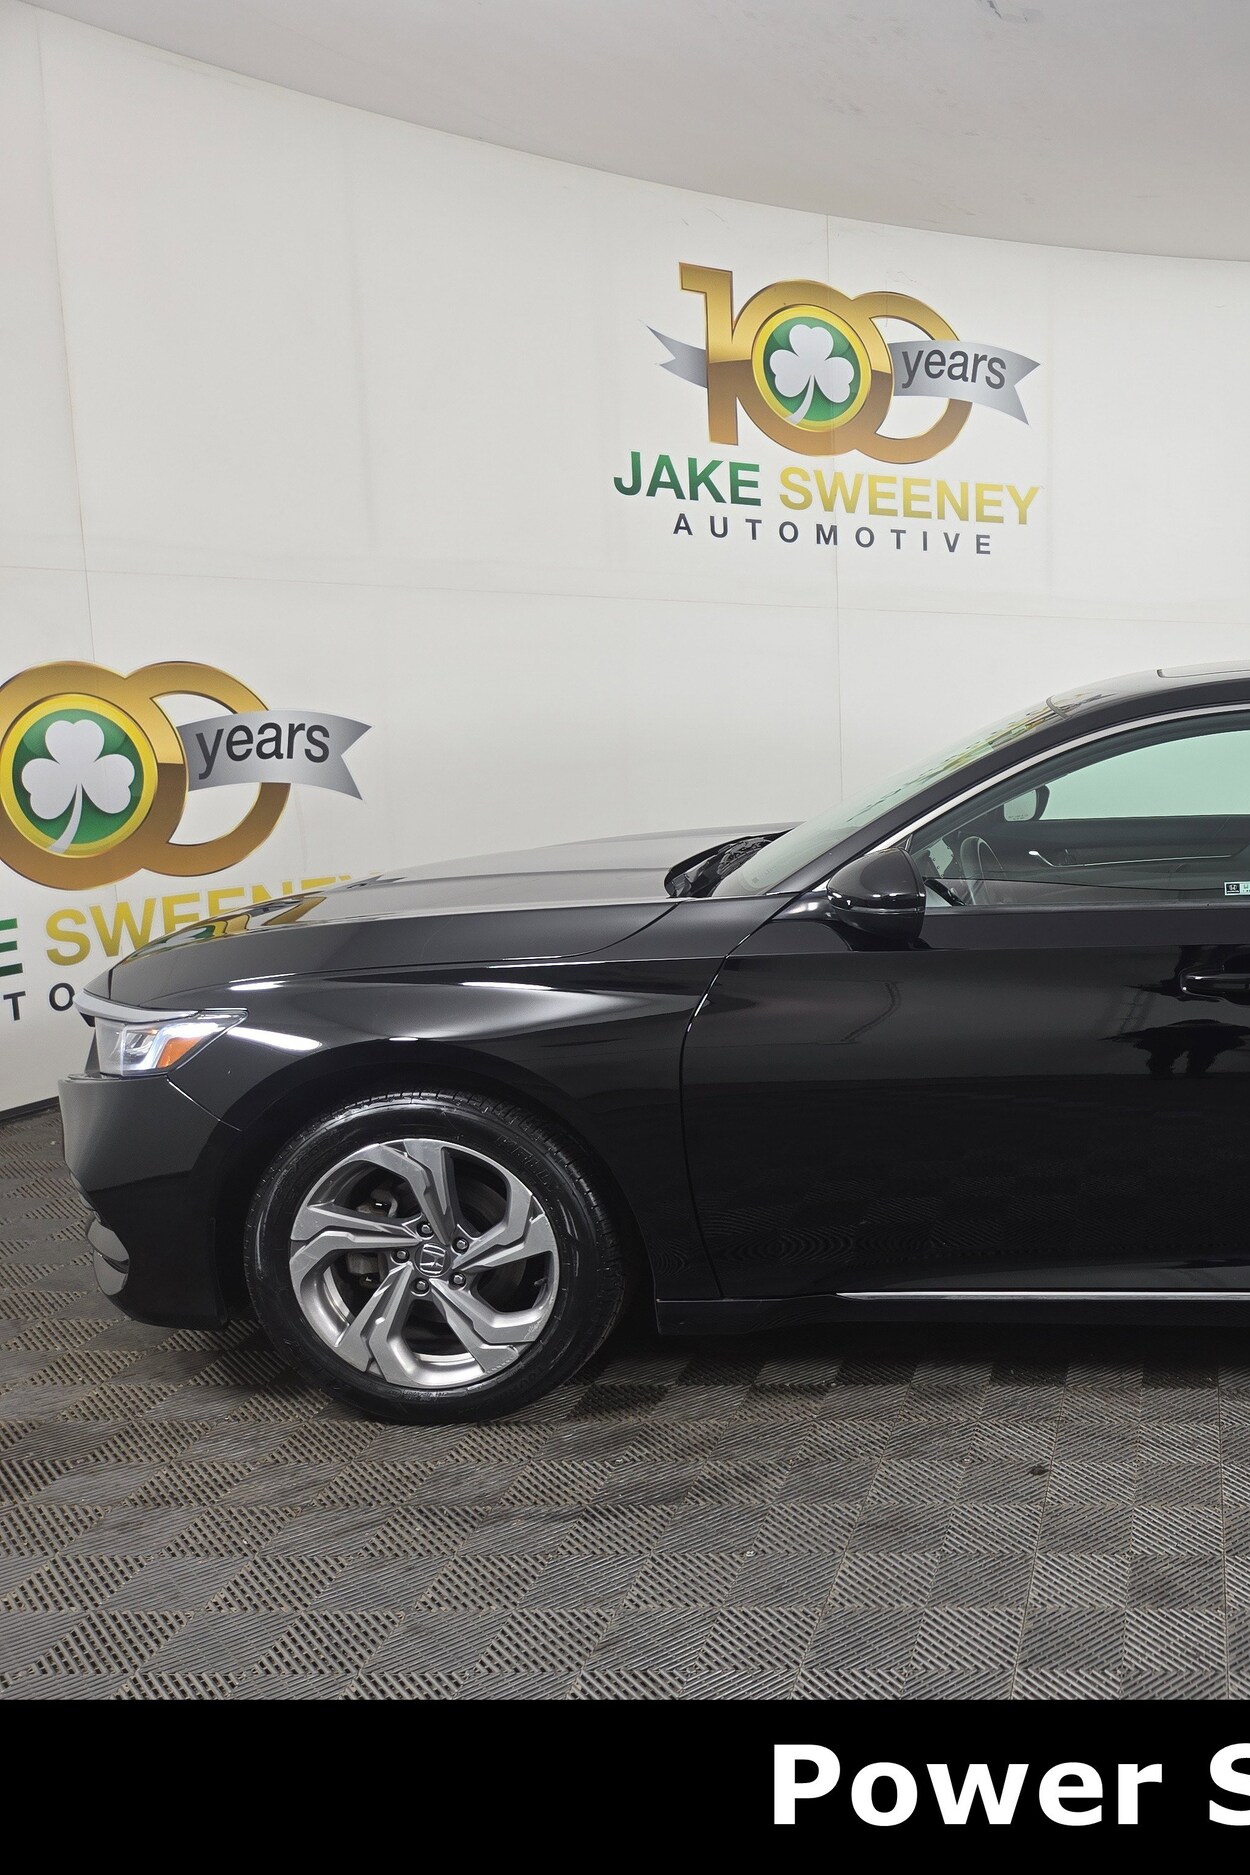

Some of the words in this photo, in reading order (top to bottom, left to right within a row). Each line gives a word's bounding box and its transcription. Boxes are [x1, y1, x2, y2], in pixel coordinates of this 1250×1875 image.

[901, 346, 1007, 390] years
[613, 451, 761, 506] JAKE
[779, 467, 1039, 525] SWEENEY
[672, 513, 991, 555] AUTOMOTIVE
[196, 721, 330, 779] years
